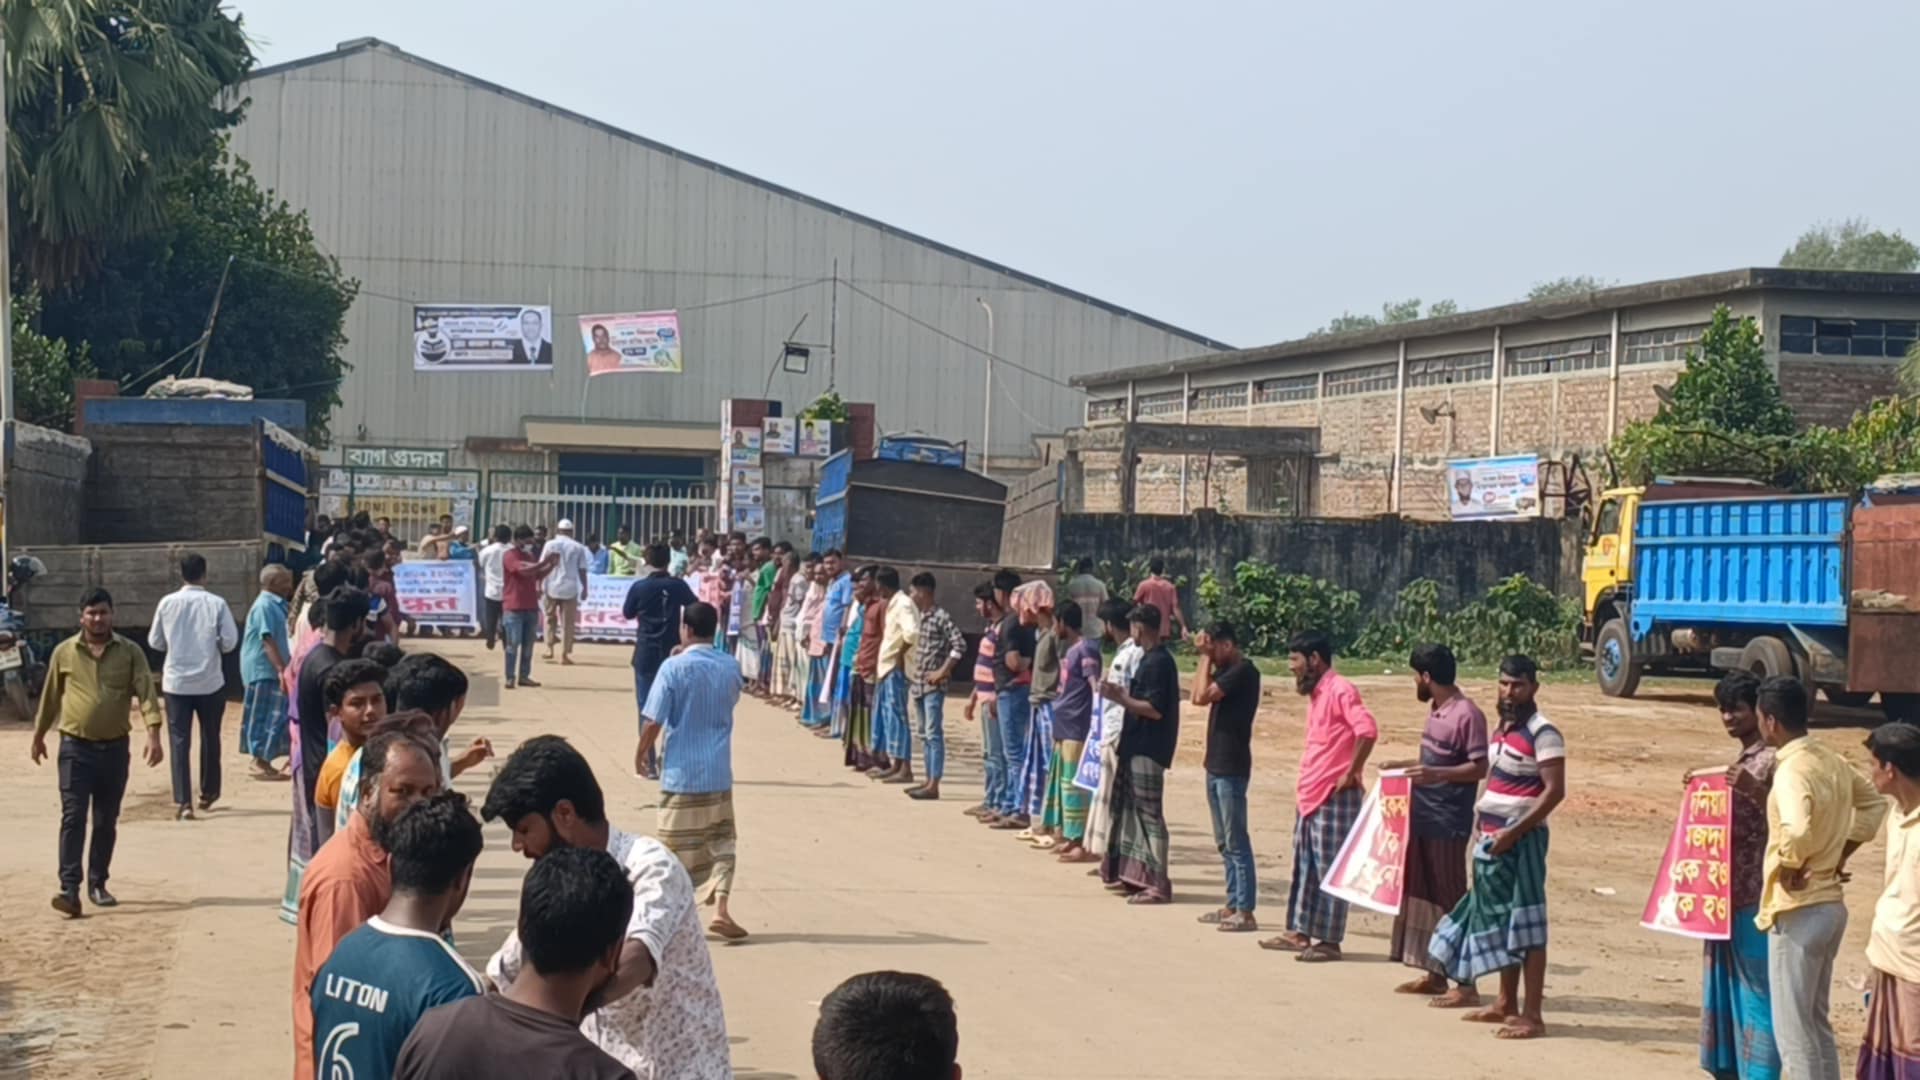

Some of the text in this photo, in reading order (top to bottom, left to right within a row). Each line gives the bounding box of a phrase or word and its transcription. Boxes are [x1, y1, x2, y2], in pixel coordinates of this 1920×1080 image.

[348, 448, 445, 468] ব্যাগ গুদাম
[1669, 859, 1728, 890] এক হও
[1702, 894, 1727, 926] হও
[325, 973, 389, 1013] LITON
[318, 1022, 359, 1080] 6
